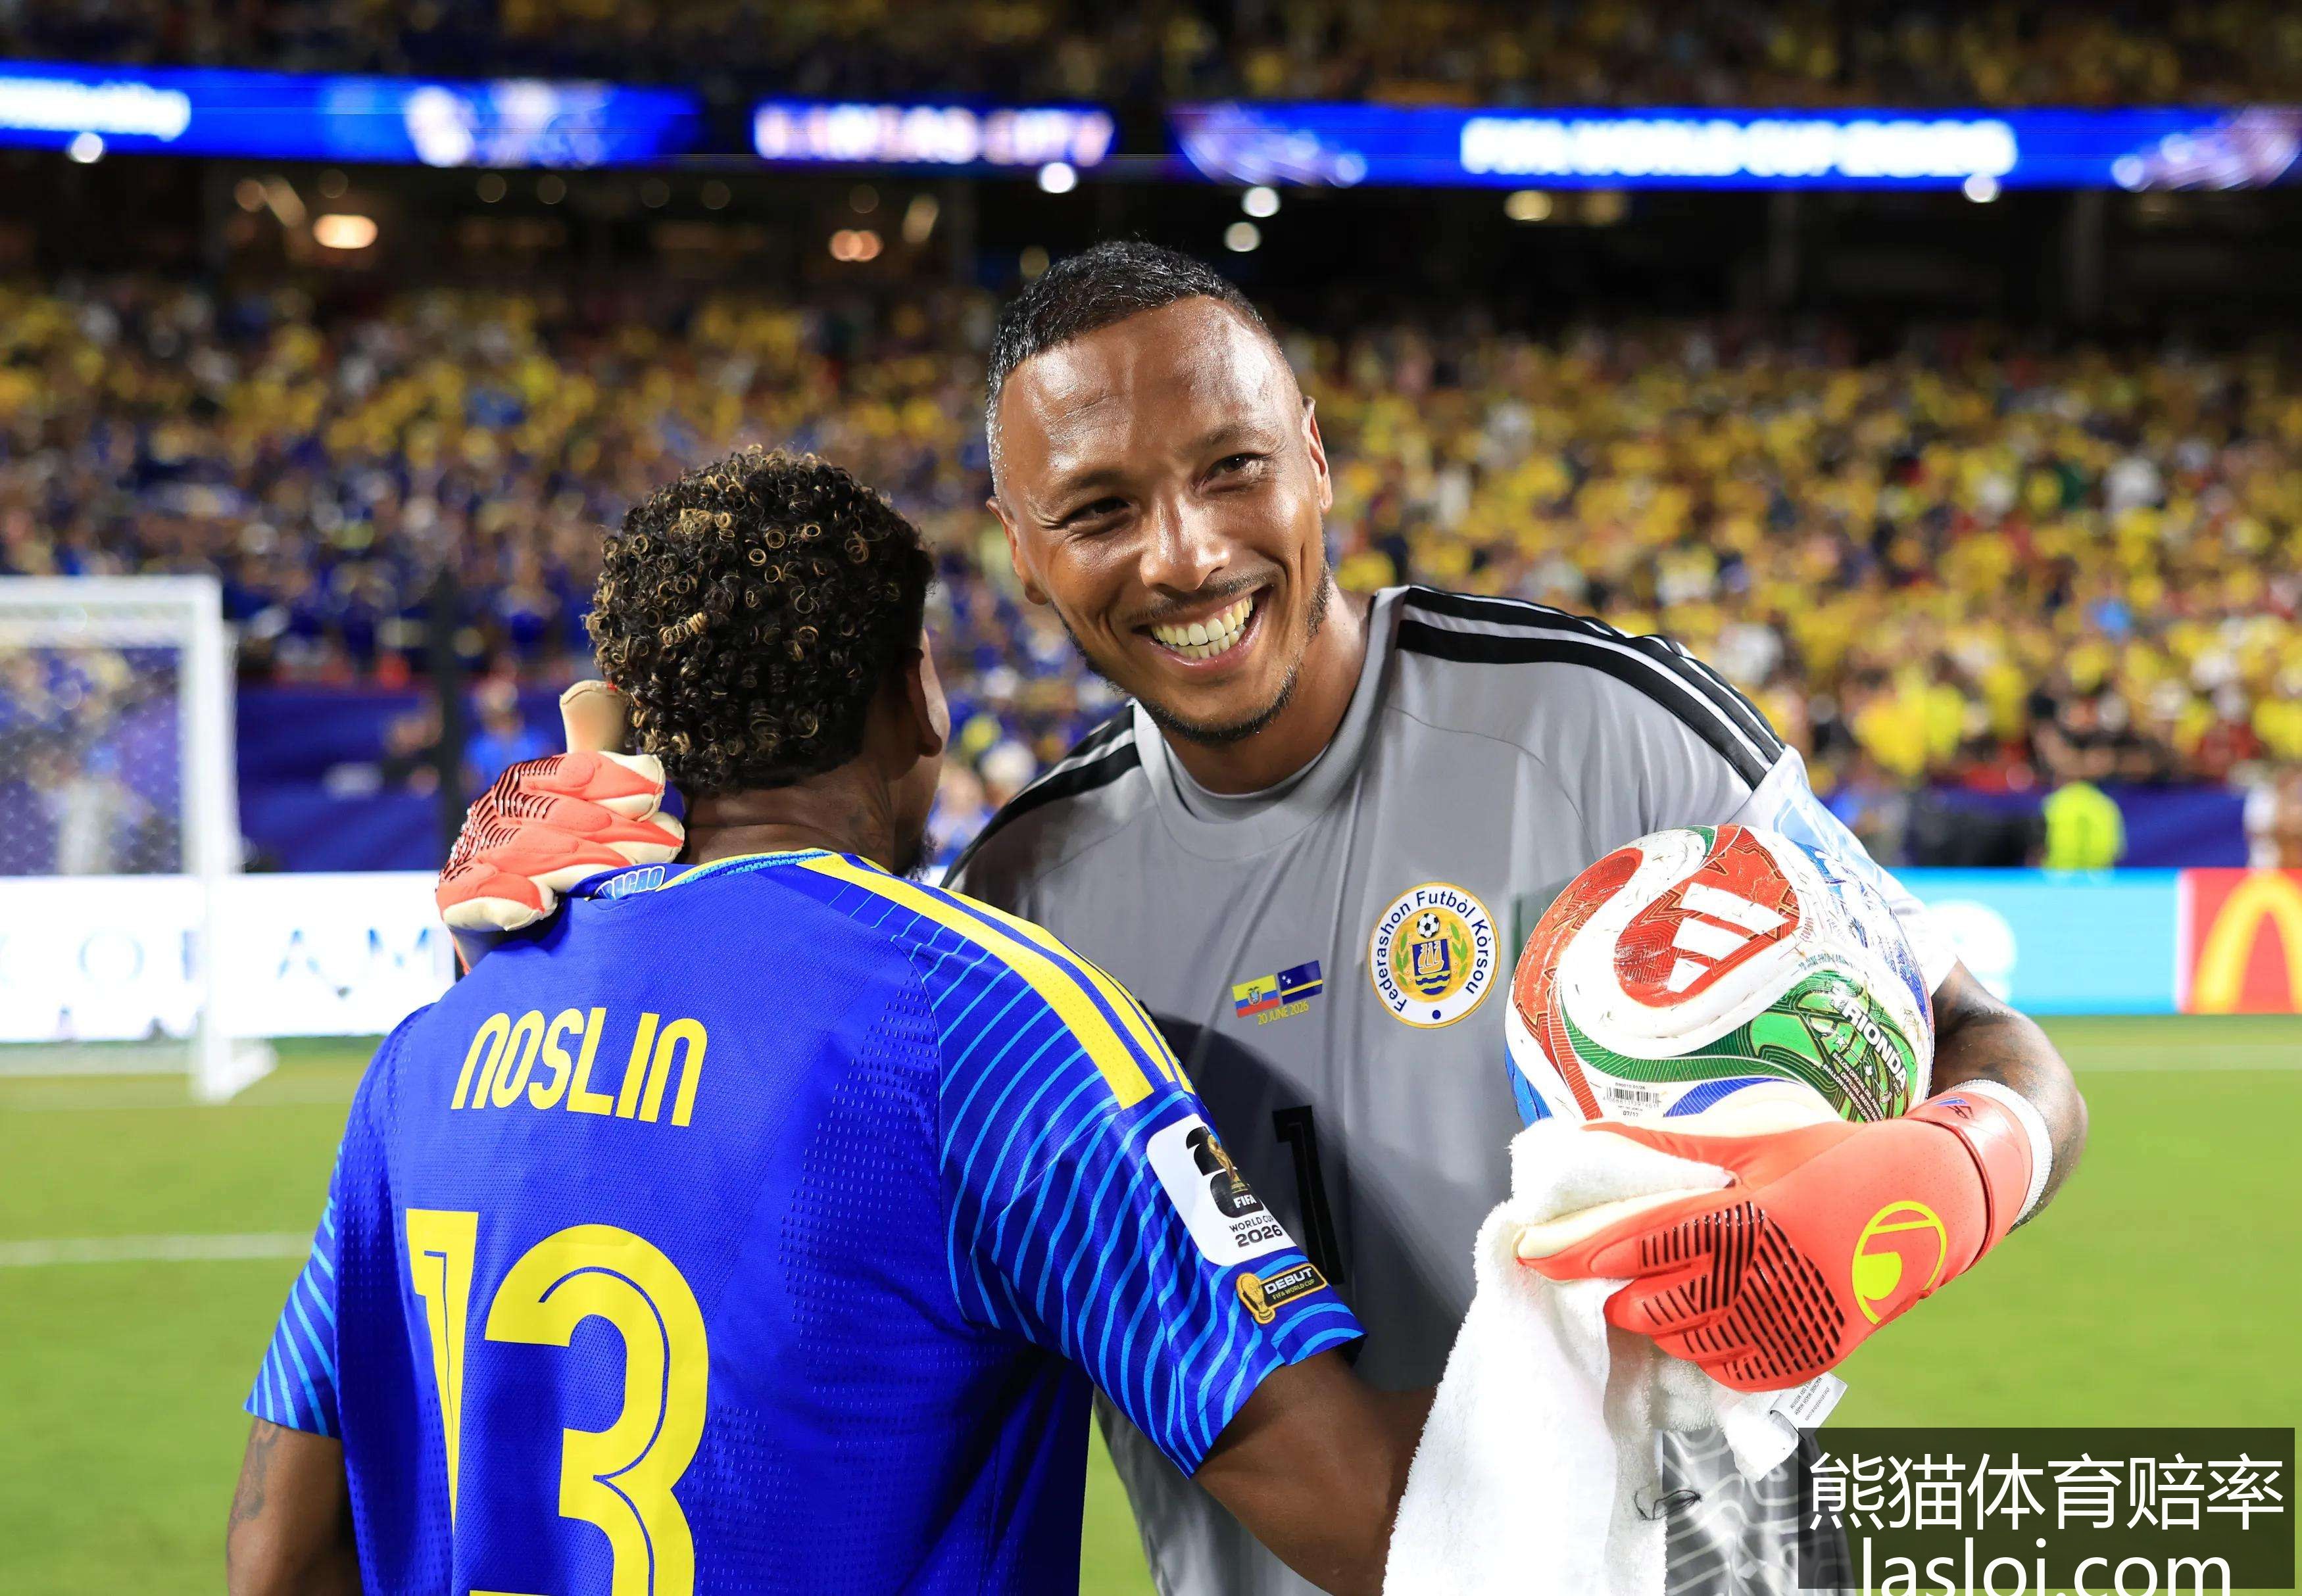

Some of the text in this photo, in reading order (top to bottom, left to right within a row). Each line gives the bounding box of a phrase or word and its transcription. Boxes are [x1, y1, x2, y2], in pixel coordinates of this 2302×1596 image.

[1377, 890, 1492, 1012] Federashon Futbòl Kòrsou
[1258, 1000, 1310, 1025] 20 JUNE 2026
[451, 1007, 708, 1127] NOSLIN
[1823, 1064, 1843, 1087] BALLON
[1842, 1084, 1849, 1094] DE
[1849, 1092, 1863, 1113] MATCH
[1840, 1073, 1860, 1096] OFFICIAL
[1859, 1095, 1874, 1114] MATCH
[1849, 1070, 1865, 1092] OFICIAL
[1864, 1088, 1873, 1101] DEL
[1872, 1098, 1884, 1120] PARTIDO
[1893, 1082, 1901, 1097] PRO
[1233, 1194, 1258, 1209] FIFA
[1273, 1105, 1344, 1285] 1
[1229, 1217, 1262, 1232] WORLD
[1235, 1224, 1283, 1248] 2026
[1264, 1268, 1312, 1295] DEBUT
[1273, 1279, 1315, 1300] FIFA WORLD CUP
[406, 1209, 709, 1596] 13
